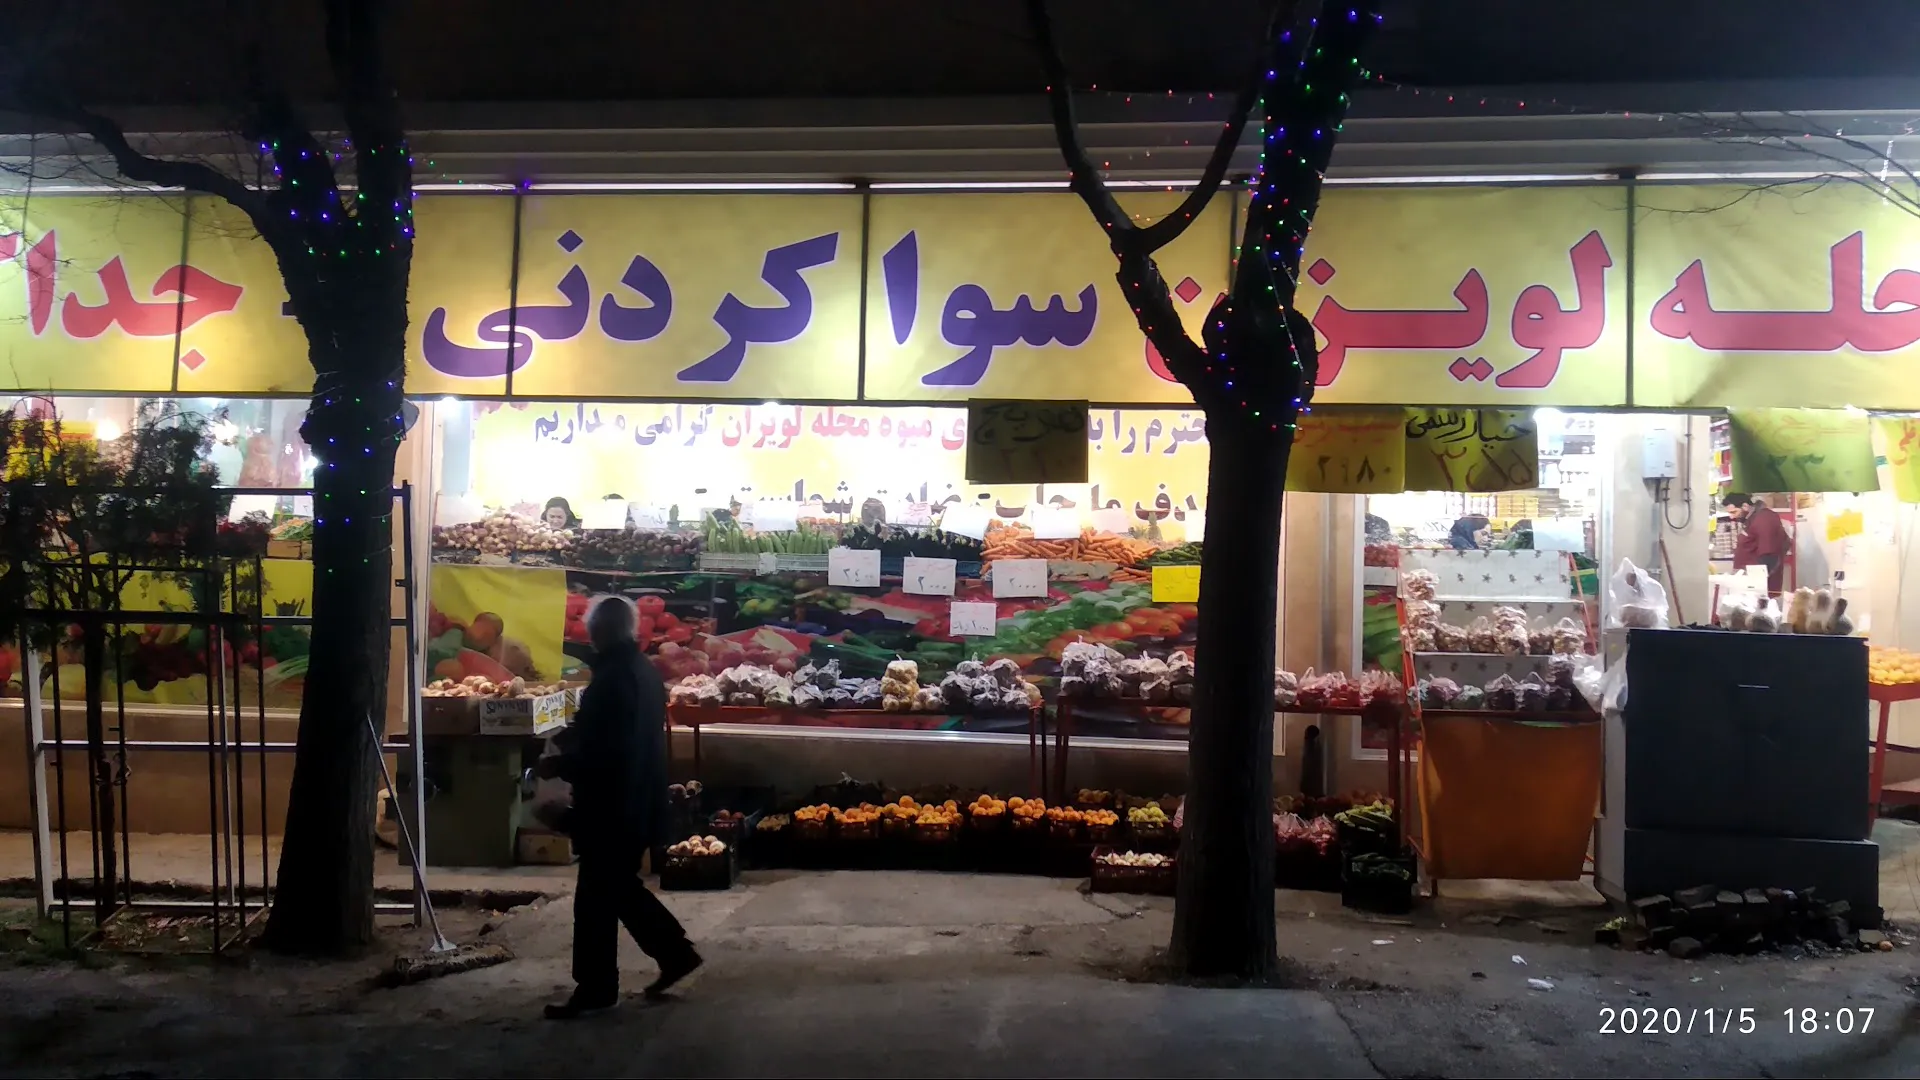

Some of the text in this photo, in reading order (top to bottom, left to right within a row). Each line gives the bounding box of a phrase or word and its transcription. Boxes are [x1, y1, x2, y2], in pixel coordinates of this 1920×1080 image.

[27, 229, 244, 371] جدا
[423, 229, 839, 381] کردنی
[883, 229, 1098, 386] سوا
[1650, 230, 1920, 351] حله
[812, 406, 870, 438] محله
[1113, 410, 1136, 453] را
[1146, 412, 1206, 454] حترم
